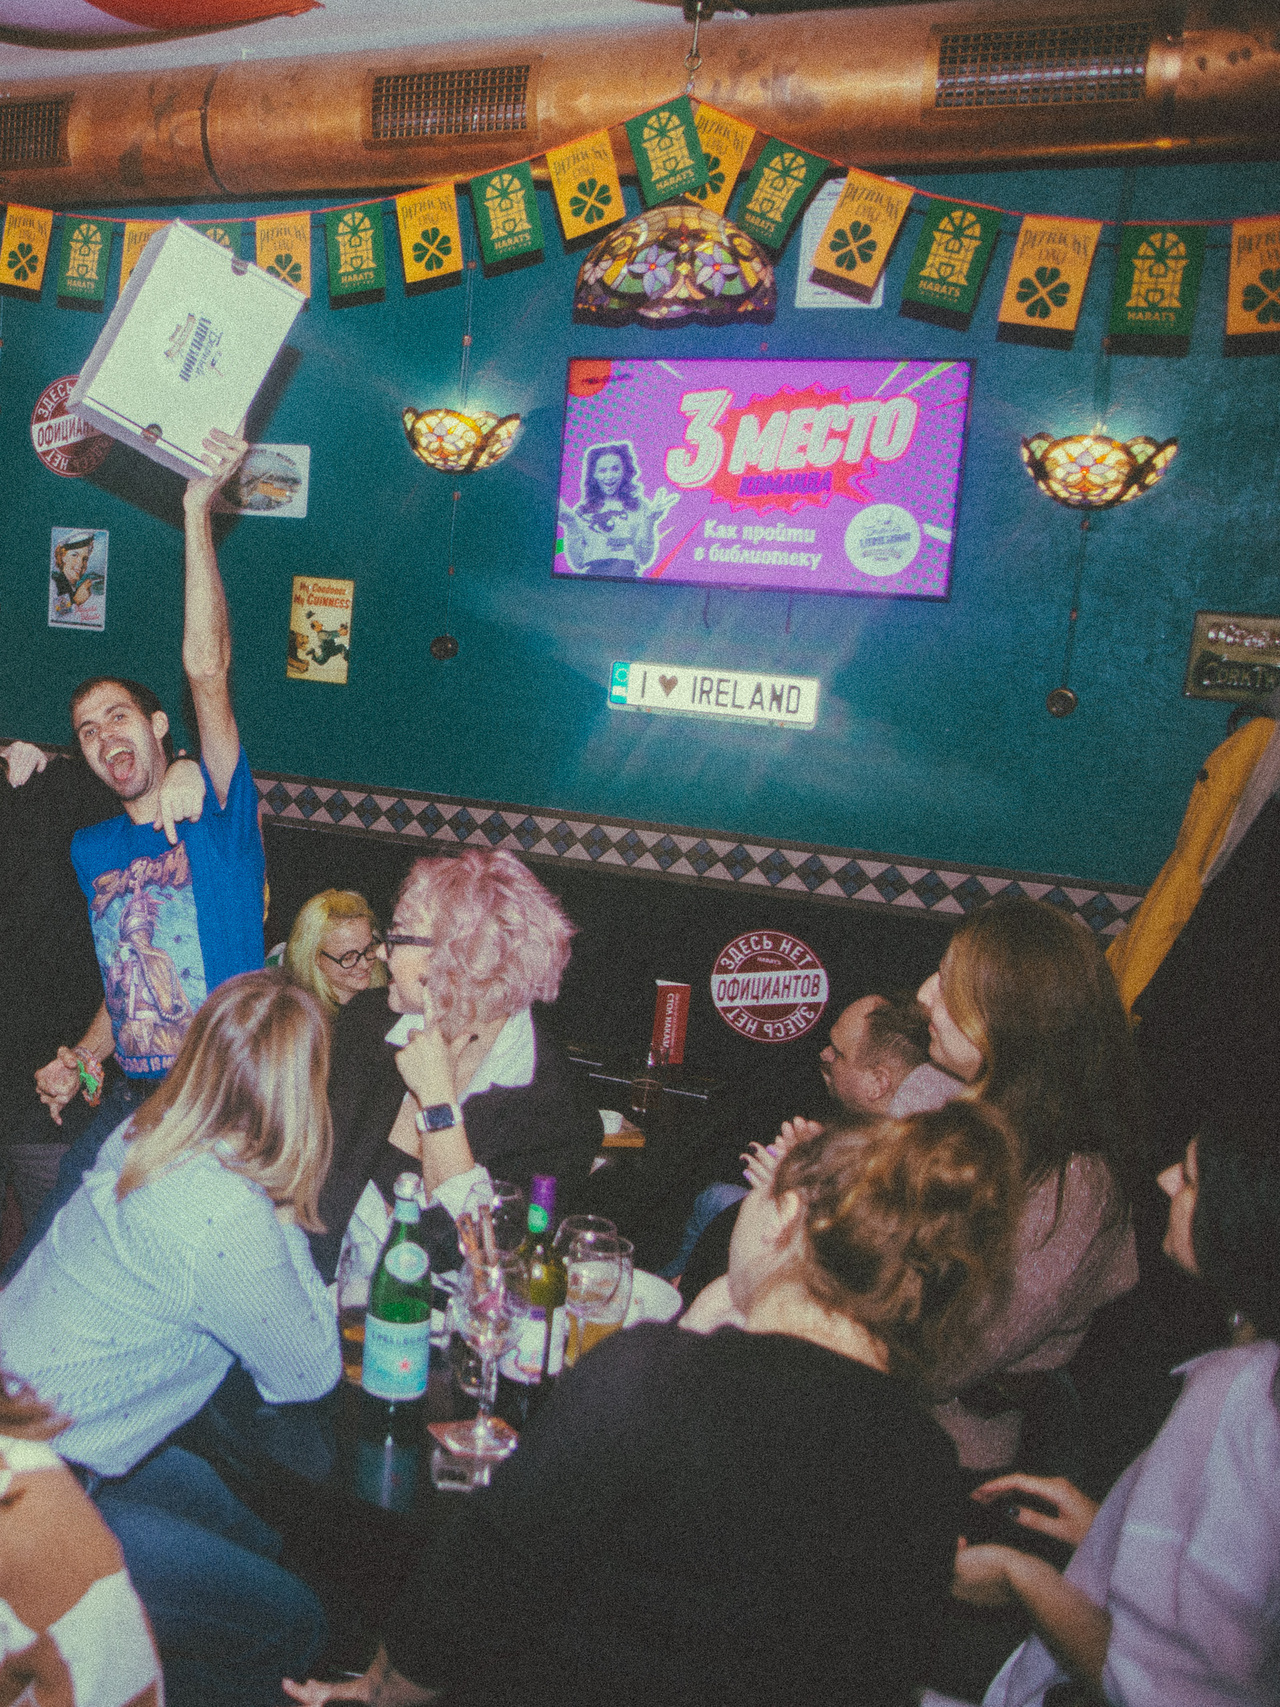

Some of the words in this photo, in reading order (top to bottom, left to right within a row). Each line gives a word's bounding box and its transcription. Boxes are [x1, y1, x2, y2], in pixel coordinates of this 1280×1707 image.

[666, 388, 733, 488] 3
[727, 397, 918, 476] МЕСТО
[46, 450, 69, 471] НЕТ
[704, 519, 738, 539] Как
[742, 522, 816, 545] пройти
[694, 546, 705, 561] в
[708, 543, 822, 571] библиотеку
[641, 671, 647, 698] I
[691, 676, 802, 715] IRELAND
[720, 935, 773, 970] ЗДЕСЬ
[779, 938, 812, 967] НЕТ
[717, 974, 821, 1003] ОФИЦИАНТОВ
[726, 1008, 758, 1034] НЕТ
[763, 1006, 815, 1038] ЗДЕСЬ
